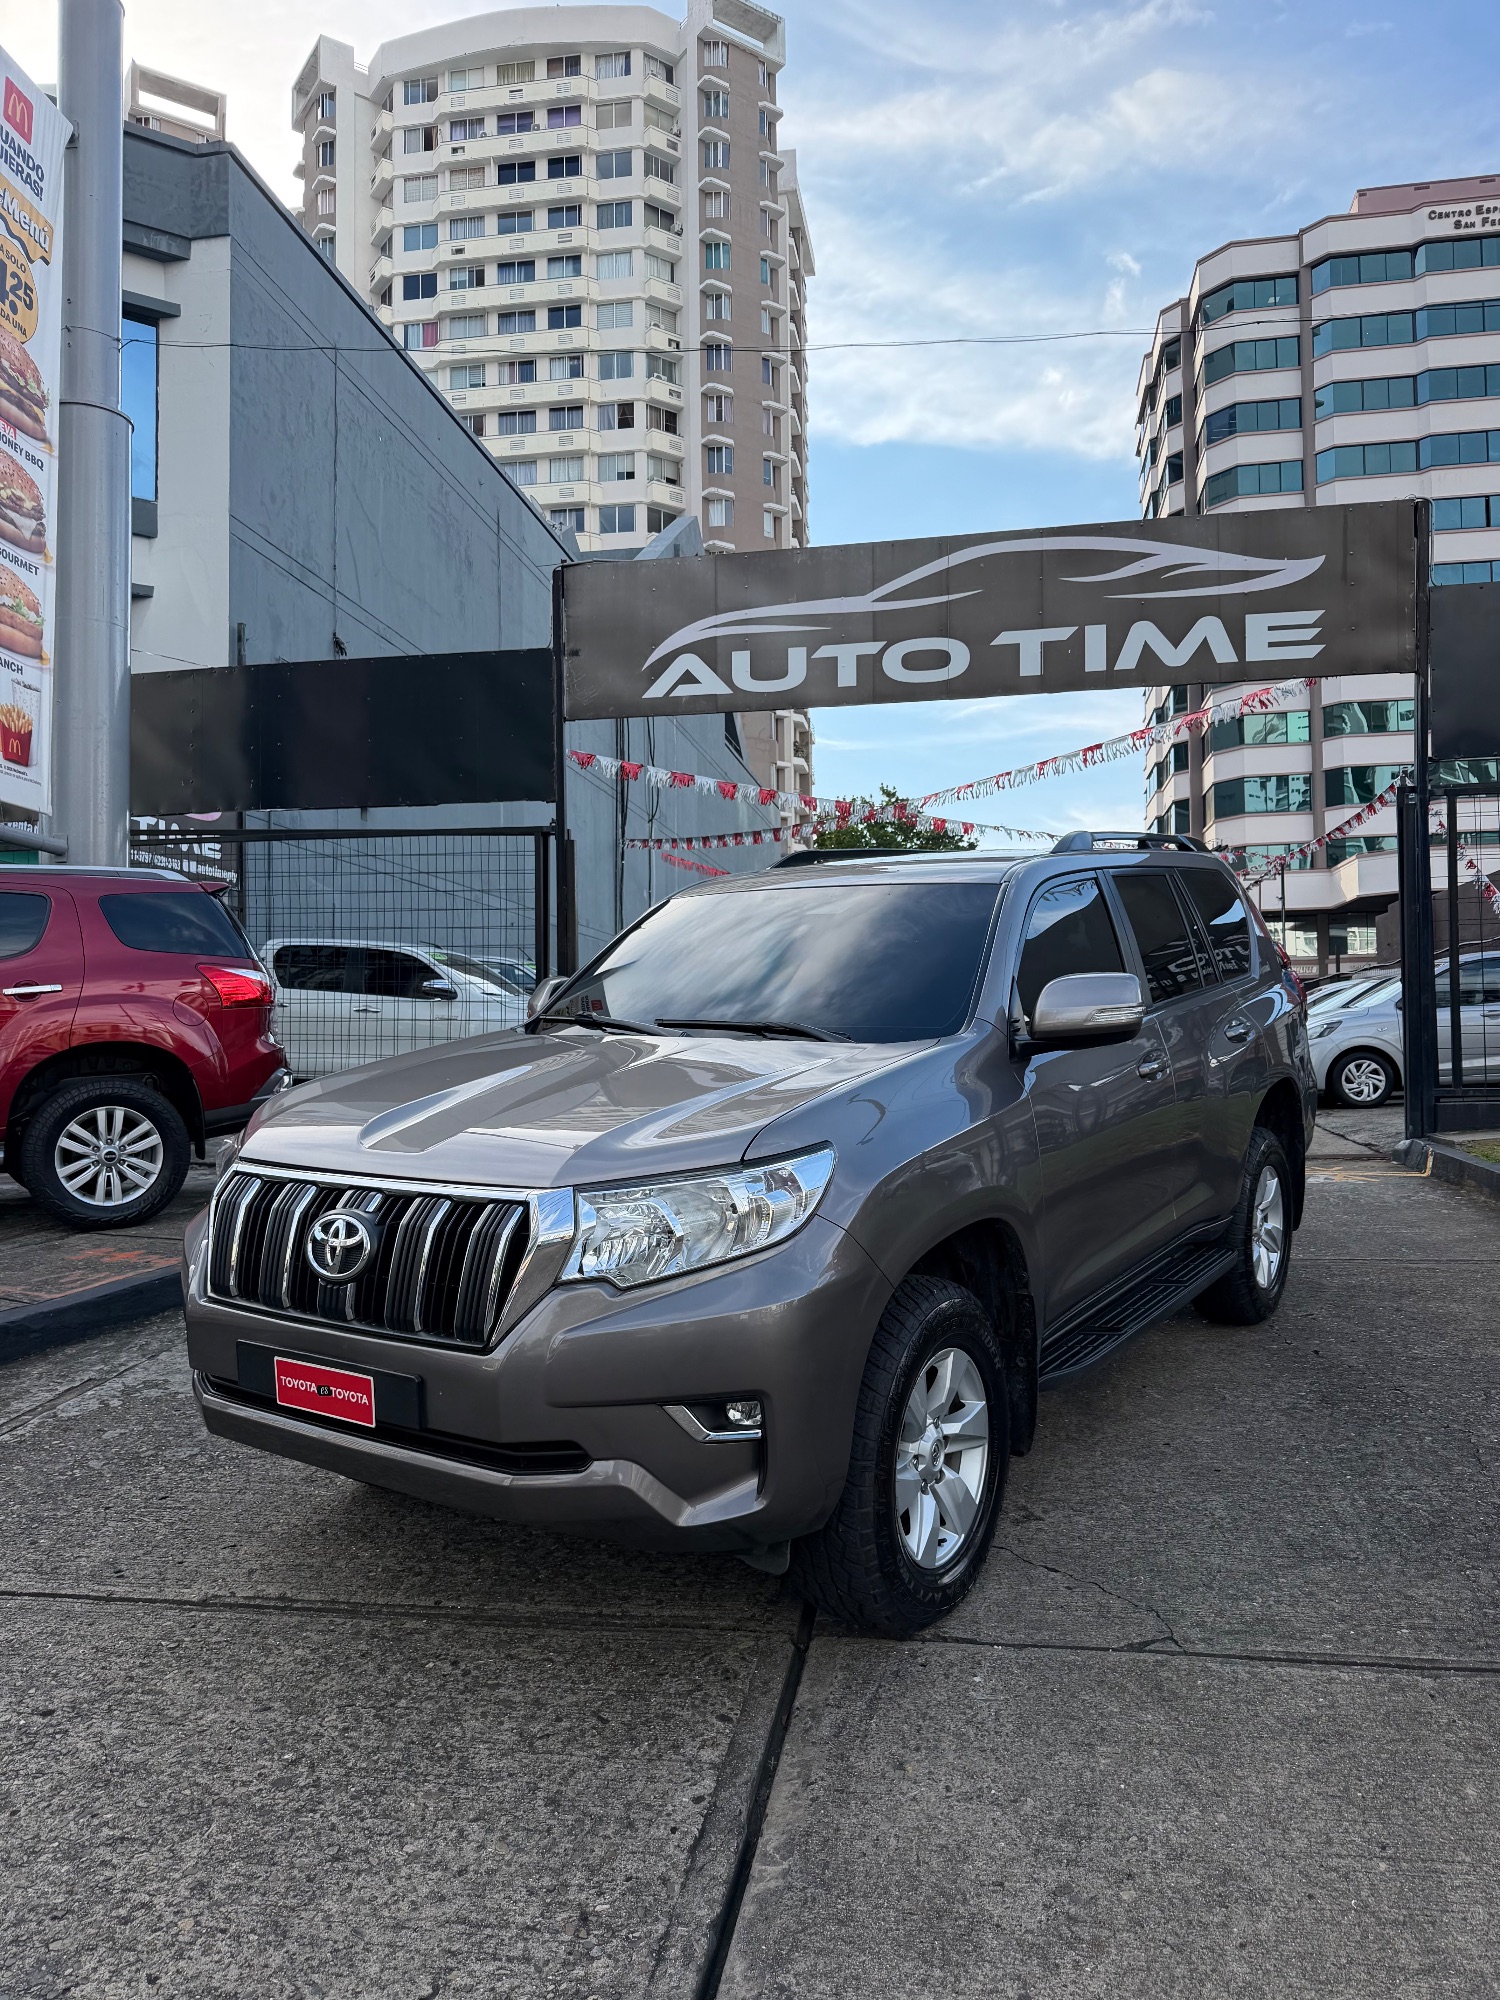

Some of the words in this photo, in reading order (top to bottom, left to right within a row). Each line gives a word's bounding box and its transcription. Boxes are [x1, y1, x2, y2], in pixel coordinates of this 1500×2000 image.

[1475, 204, 1500, 215] ESP
[1453, 219, 1476, 230] SAN
[1481, 216, 1500, 228] FE
[5, 252, 27, 274] SOLO
[12, 319, 28, 339] UNA
[0, 431, 24, 457] ONEY
[25, 449, 45, 472] BBQ
[0, 547, 40, 577] OURMET
[641, 644, 971, 700] AUTO
[990, 608, 1327, 677] TIME
[280, 1375, 318, 1394] TOYOTA
[330, 1386, 369, 1406] TOYOTA
